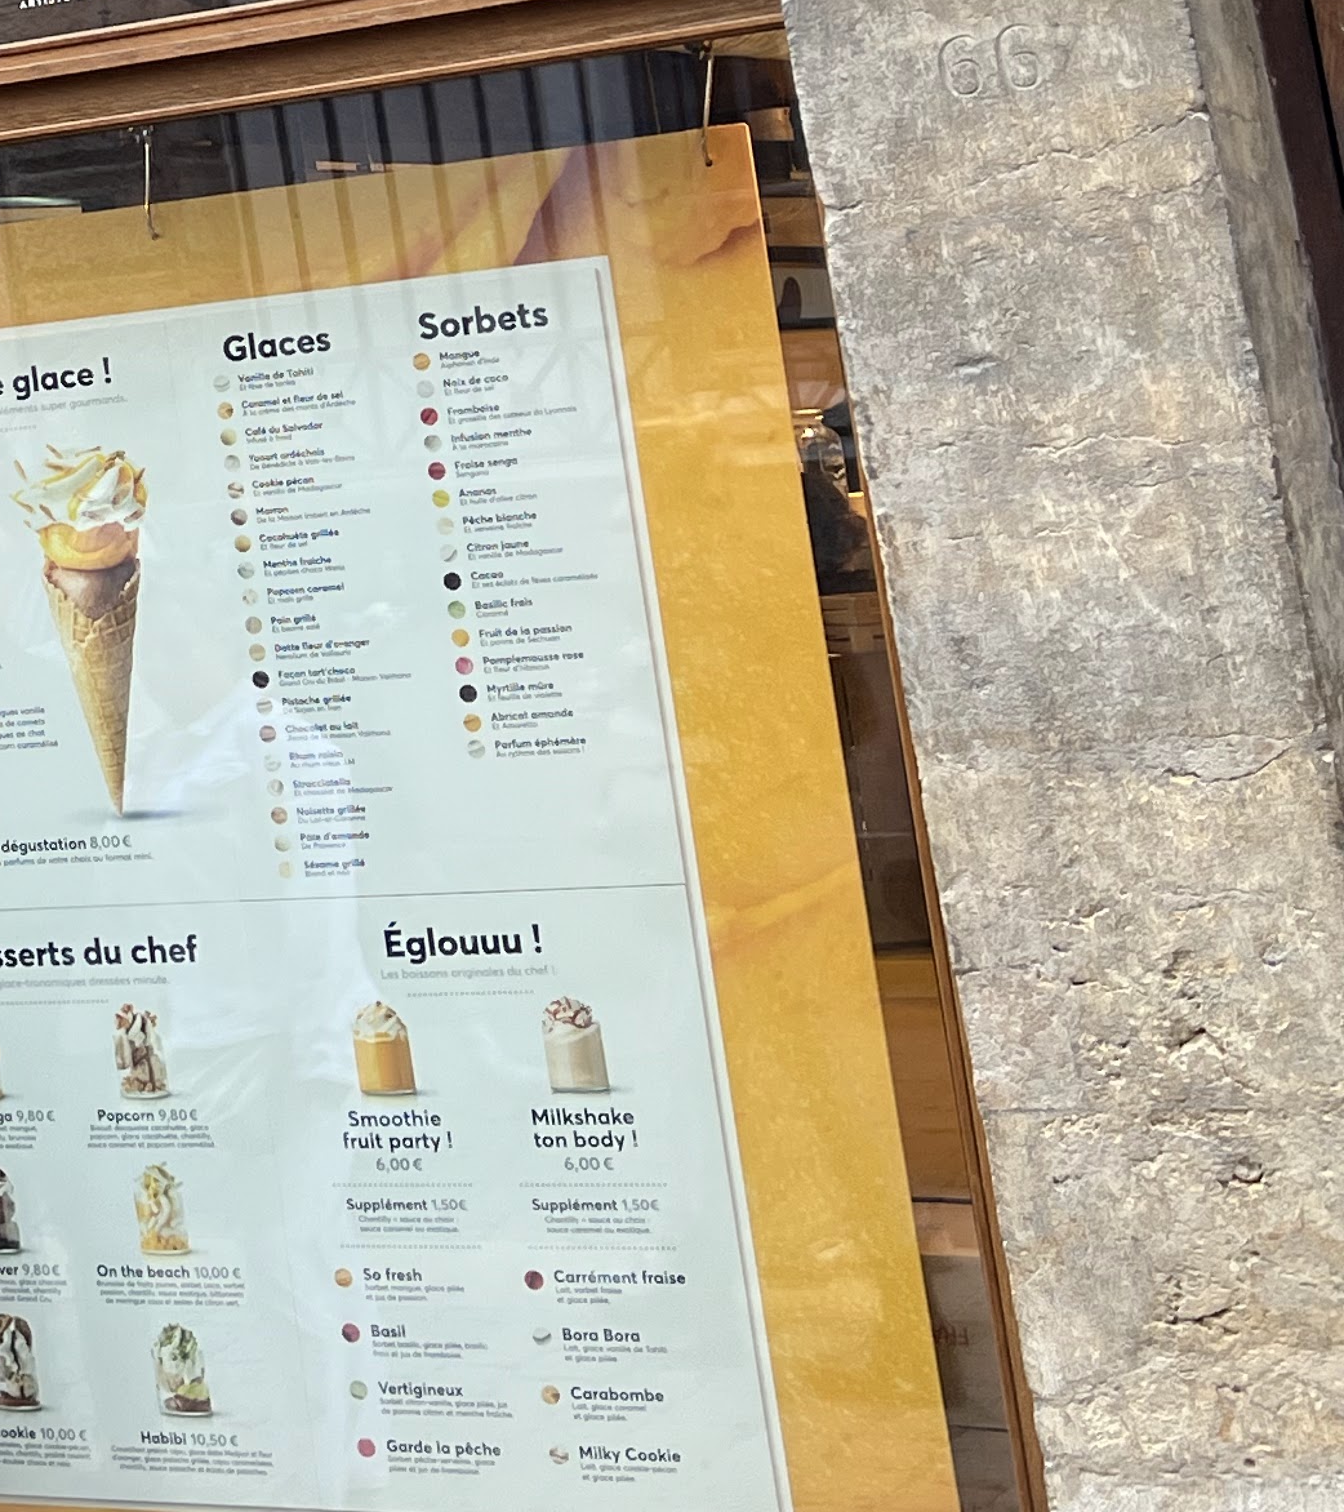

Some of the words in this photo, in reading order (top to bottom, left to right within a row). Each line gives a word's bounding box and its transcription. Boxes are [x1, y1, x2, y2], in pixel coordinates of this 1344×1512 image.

[417, 303, 548, 340] Sorbets
[222, 331, 331, 362] Glaces
[12, 364, 94, 401] glace
[0, 837, 87, 856] dégustation
[83, 937, 122, 965] du
[130, 933, 197, 964] chef
[383, 920, 522, 965] Églouuu
[96, 1108, 154, 1124] Popcorn
[347, 1109, 441, 1127] Smoothie
[530, 1106, 634, 1125] Milkshake
[342, 1131, 383, 1149] fruit
[388, 1132, 440, 1153] party
[533, 1132, 567, 1148] ton
[572, 1129, 625, 1152] body
[345, 1197, 428, 1213] Supplément
[531, 1197, 618, 1214] Supplément
[96, 1264, 117, 1277] On
[120, 1264, 143, 1278] the
[146, 1264, 190, 1278] beach
[362, 1267, 381, 1281] So
[385, 1267, 422, 1281] fresh
[553, 1269, 638, 1284] Carrément
[641, 1269, 686, 1284] fraise
[370, 1323, 406, 1338] Basil
[561, 1327, 599, 1341] Bora
[602, 1328, 640, 1342] Bora
[377, 1380, 463, 1399] Vertigineux
[570, 1386, 664, 1402] Carabombe
[140, 1430, 187, 1445] Habibi
[386, 1438, 432, 1454] Garde
[435, 1440, 450, 1454] la
[454, 1441, 501, 1457] pêche
[578, 1445, 621, 1463] Milky
[624, 1447, 681, 1462] Cookie
